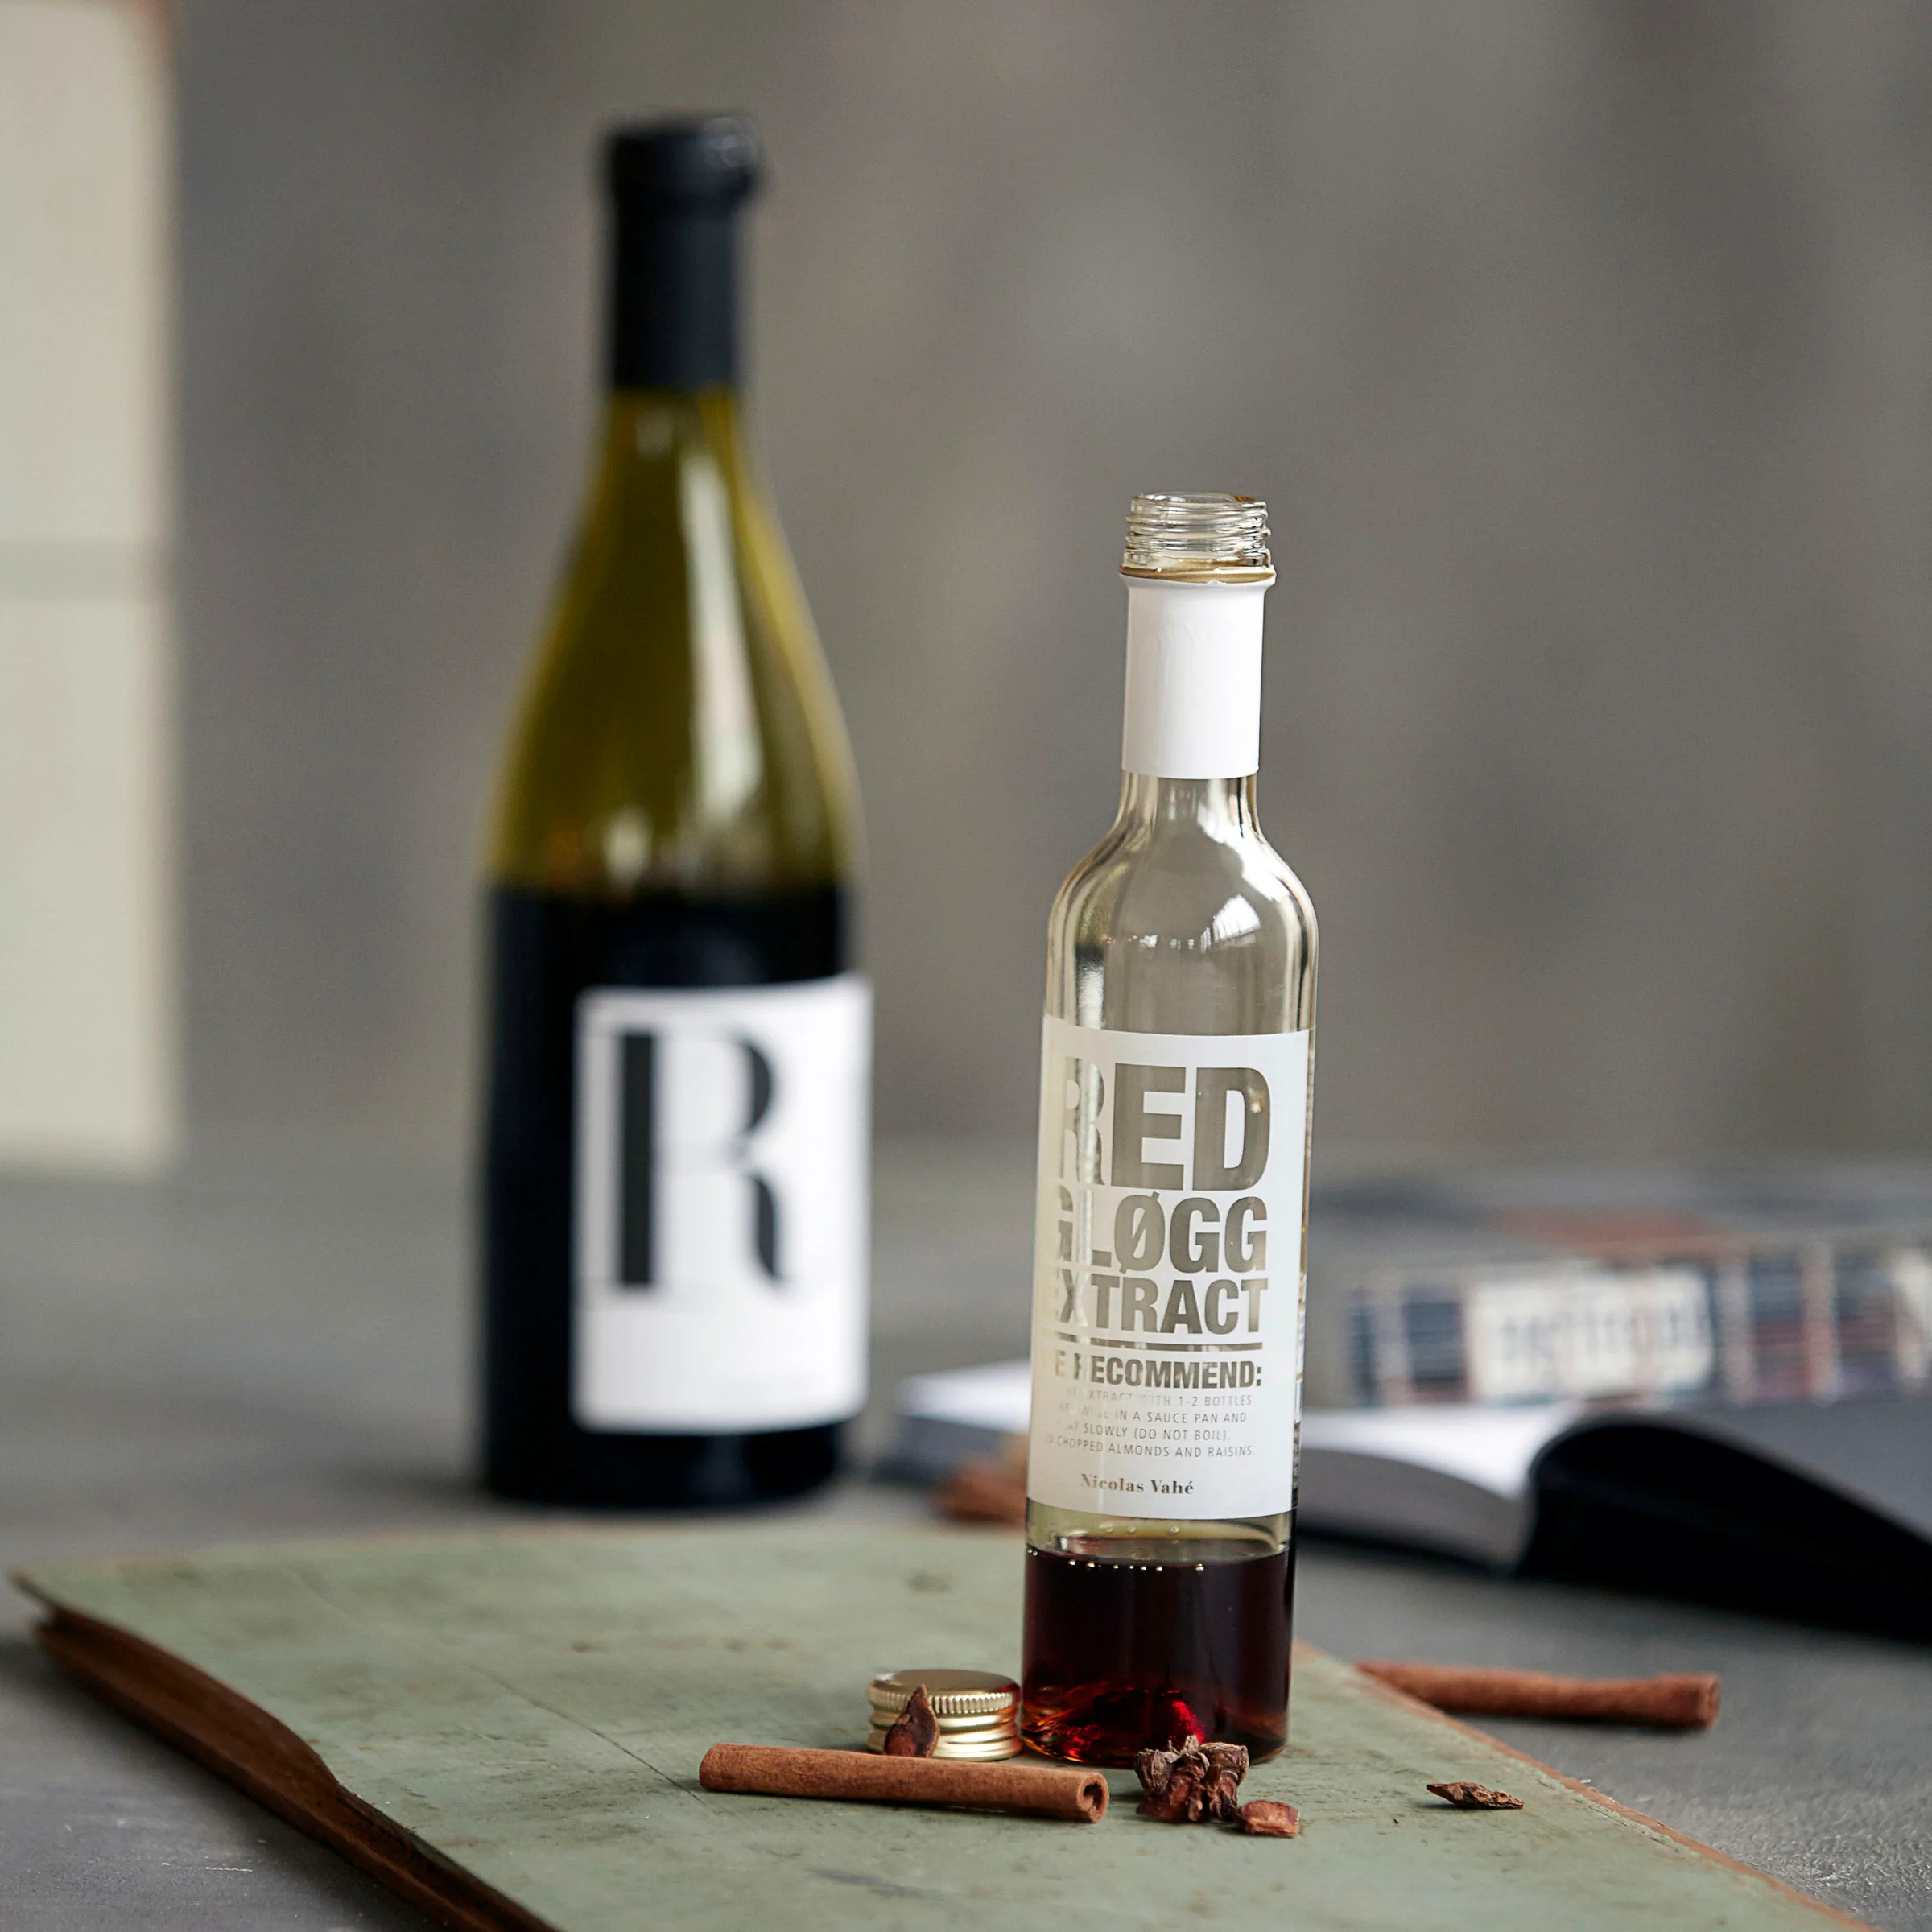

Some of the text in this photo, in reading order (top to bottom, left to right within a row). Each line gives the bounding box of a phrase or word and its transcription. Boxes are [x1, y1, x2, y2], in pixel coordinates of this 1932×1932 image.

[1059, 1055, 1270, 1191] RED
[616, 1026, 791, 1294] R
[1053, 1266, 1269, 1335] XTRACT
[1179, 1395, 1199, 1407] 1-2
[1204, 1394, 1253, 1407] BOTTLES
[1115, 1410, 1127, 1421] IN
[1133, 1410, 1141, 1422] A
[1147, 1411, 1188, 1424] SAUCE
[1195, 1413, 1218, 1424] PAN
[1224, 1412, 1247, 1423] AND
[1084, 1422, 1128, 1438] SLOWLY
[1134, 1427, 1157, 1440] (DO
[1163, 1429, 1188, 1441] NOT
[1195, 1430, 1231, 1443] BOIL).
[1056, 1435, 1103, 1452] CHOPPED
[1108, 1443, 1170, 1457] ALMONDS
[1175, 1447, 1202, 1458] AND
[1208, 1445, 1256, 1457] RAISINS.
[1080, 1472, 1195, 1495] Nicolas Vahé
